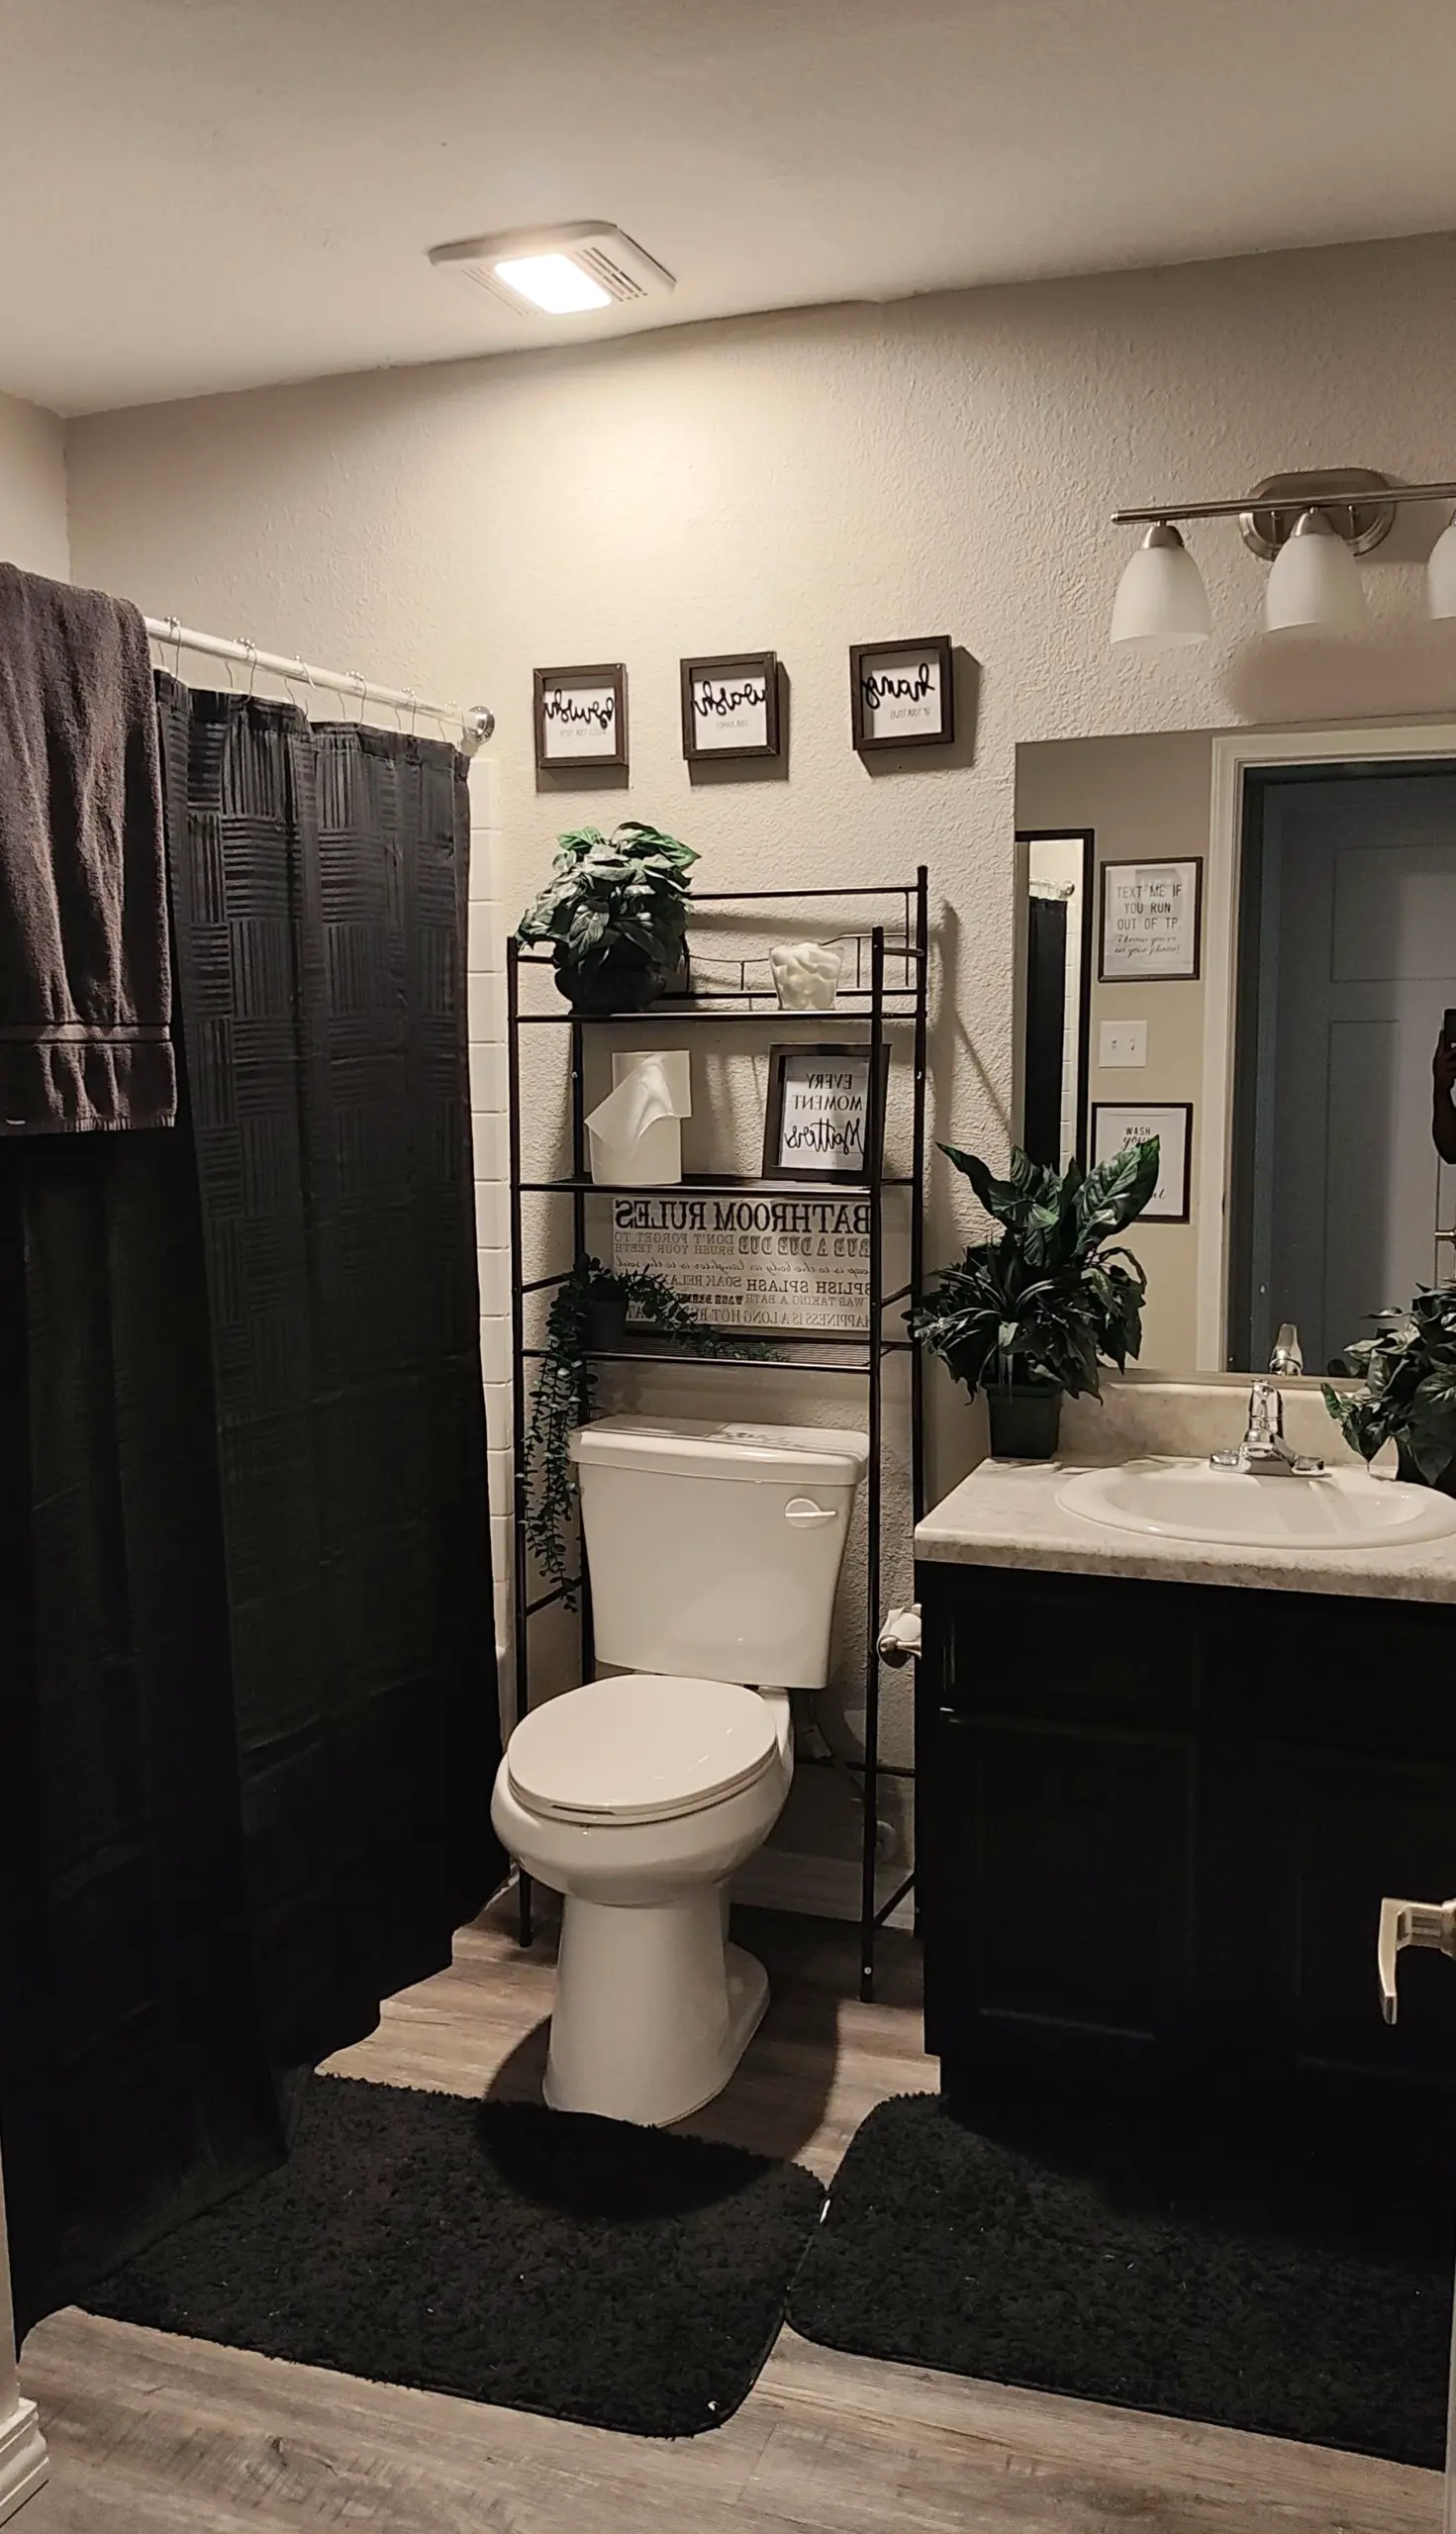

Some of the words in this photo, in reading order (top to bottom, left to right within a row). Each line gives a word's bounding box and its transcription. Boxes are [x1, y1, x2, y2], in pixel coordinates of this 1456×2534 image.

[1116, 884, 1142, 899] TEXT
[1149, 883, 1166, 898] ME
[1172, 883, 1183, 898] IF
[1124, 902, 1144, 915] YOU
[1150, 901, 1171, 914] RUN
[1116, 918, 1137, 930] OUT
[1144, 917, 1158, 929] OF
[1165, 917, 1179, 929] TP
[1124, 1126, 1151, 1136] WASH
[1122, 1135, 1149, 1151] you
